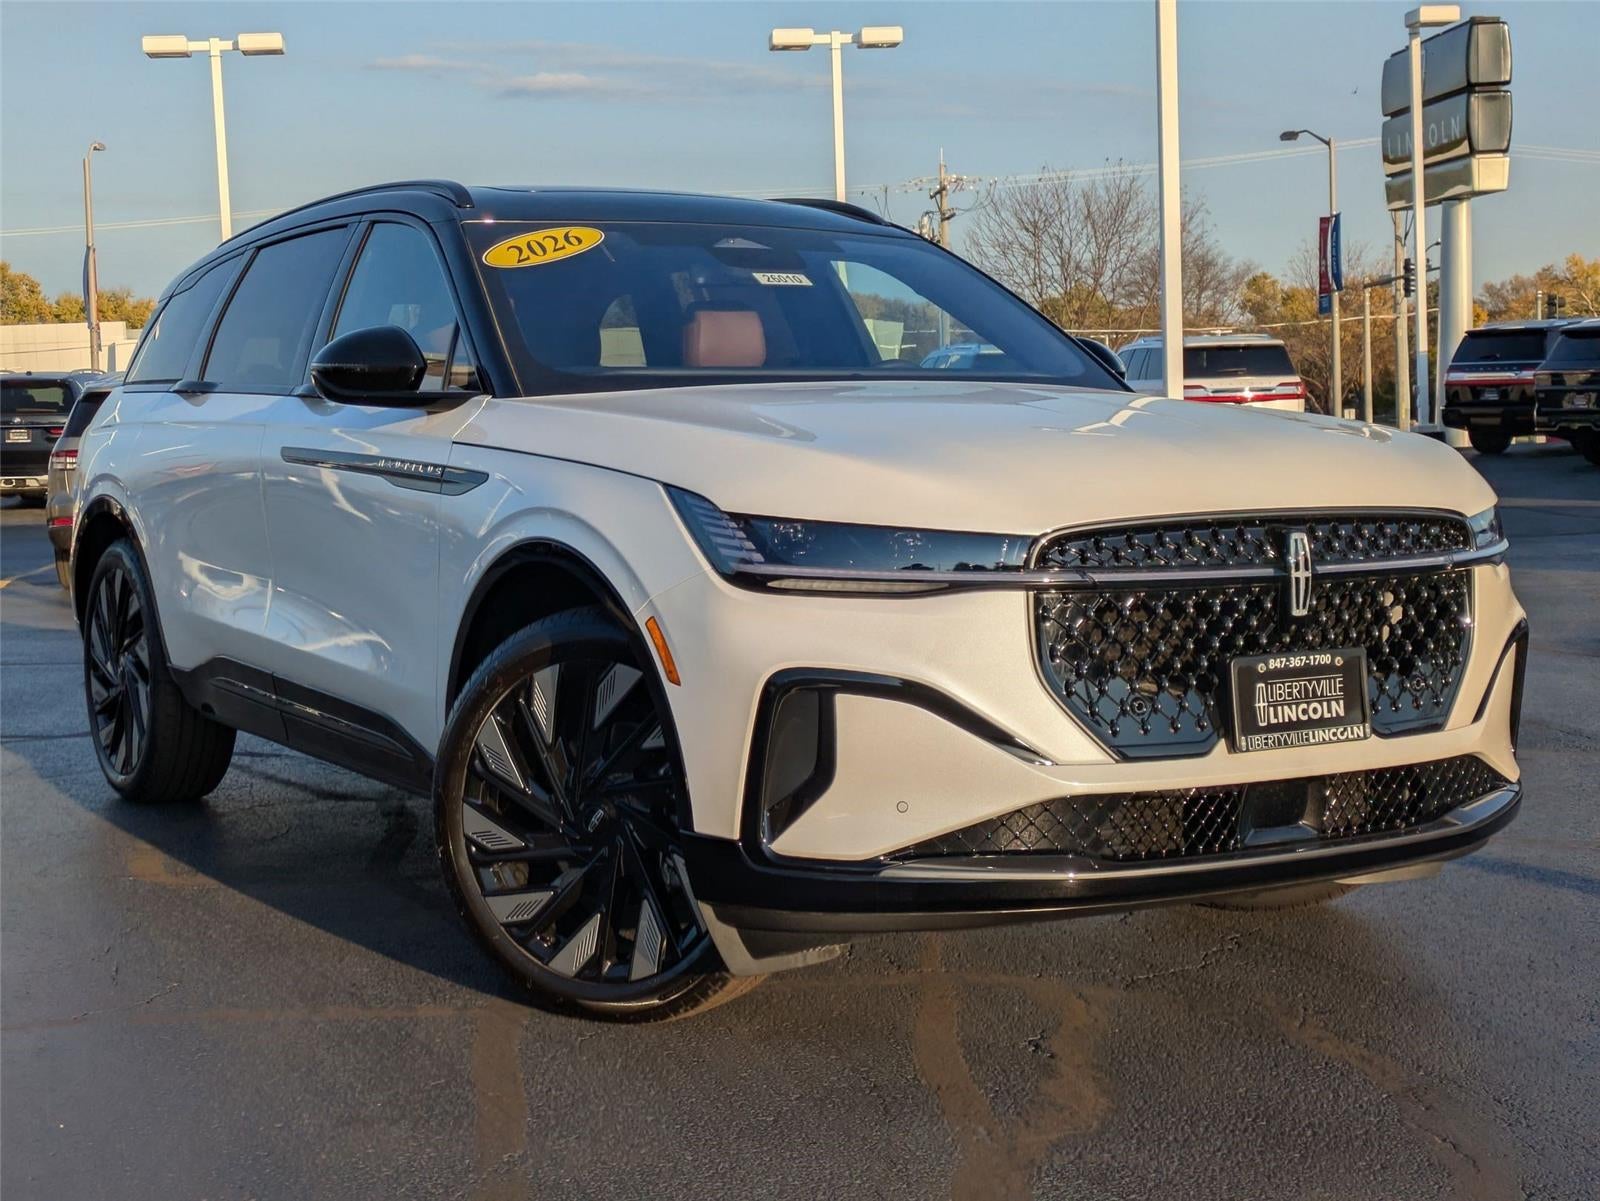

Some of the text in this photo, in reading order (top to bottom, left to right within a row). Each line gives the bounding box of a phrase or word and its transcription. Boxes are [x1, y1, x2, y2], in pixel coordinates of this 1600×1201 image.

[1387, 115, 1460, 159] LINOLN
[507, 229, 583, 264] 2026
[762, 274, 804, 284] 26010
[1268, 654, 1332, 669] 847-367-1700
[1267, 678, 1344, 701] LIBERTYVILLE
[1269, 699, 1345, 724] LINCOLN
